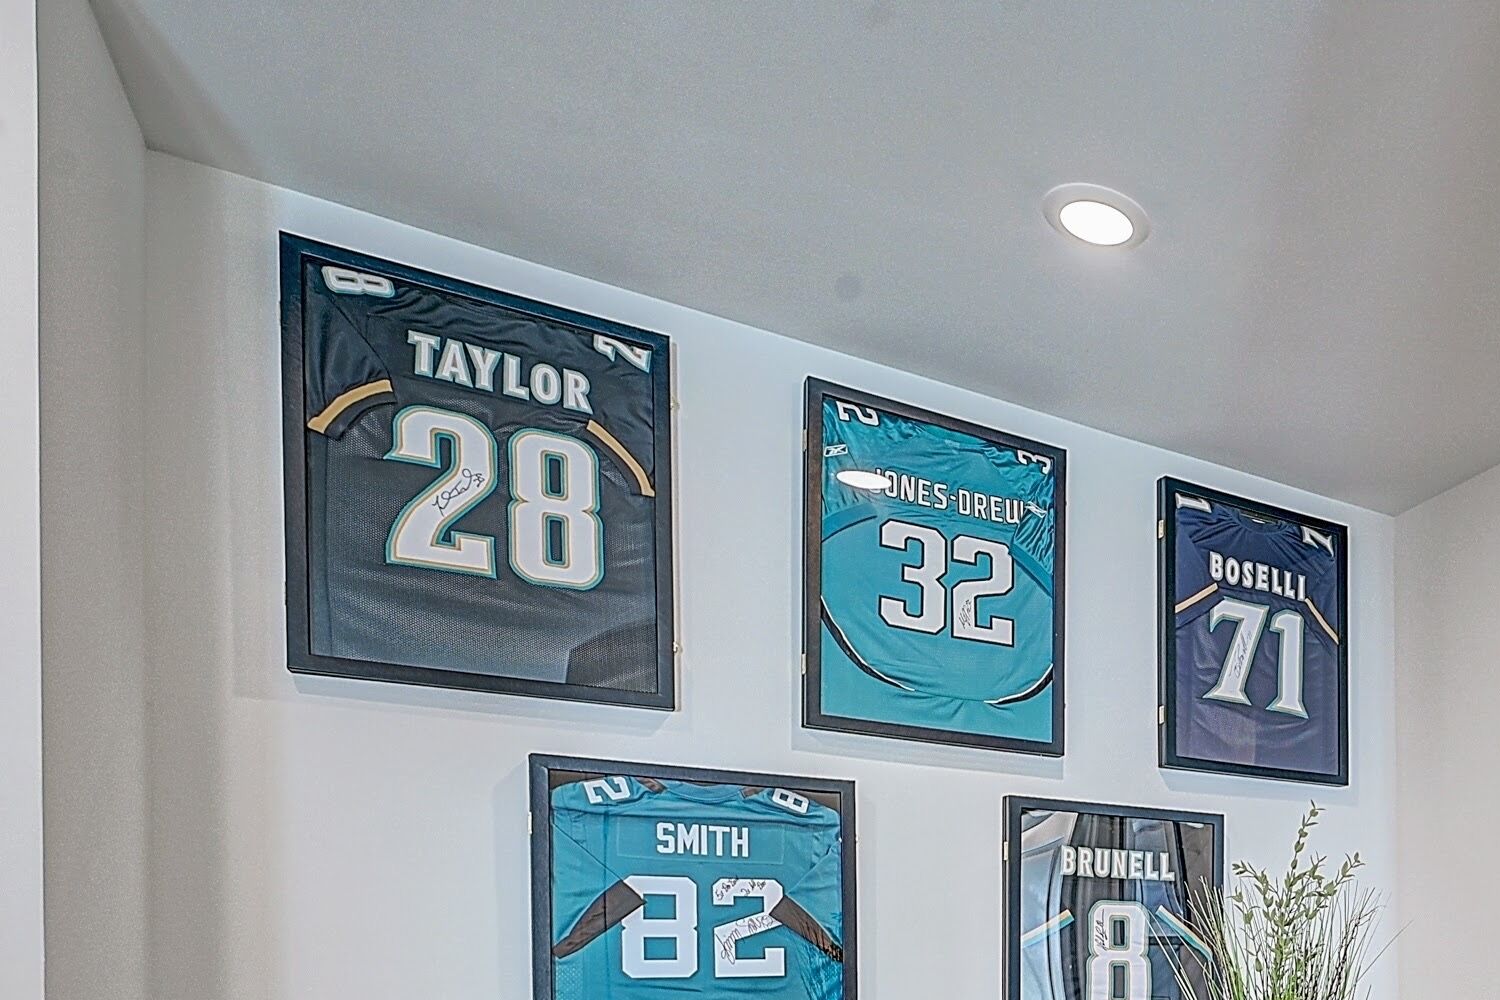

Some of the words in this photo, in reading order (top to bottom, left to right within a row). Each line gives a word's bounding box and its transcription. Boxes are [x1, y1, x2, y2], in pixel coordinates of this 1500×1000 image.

[321, 266, 395, 298] 8
[407, 329, 593, 415] TAYLOR
[383, 404, 606, 592] 28
[878, 517, 1015, 648] 32
[1208, 550, 1307, 602] BOSELLI
[1202, 596, 1310, 719] 71
[583, 775, 632, 804] 2
[771, 787, 809, 814] 8
[656, 821, 750, 858] SMITH
[1059, 844, 1176, 882] BRUNELL
[620, 874, 785, 979] 82
